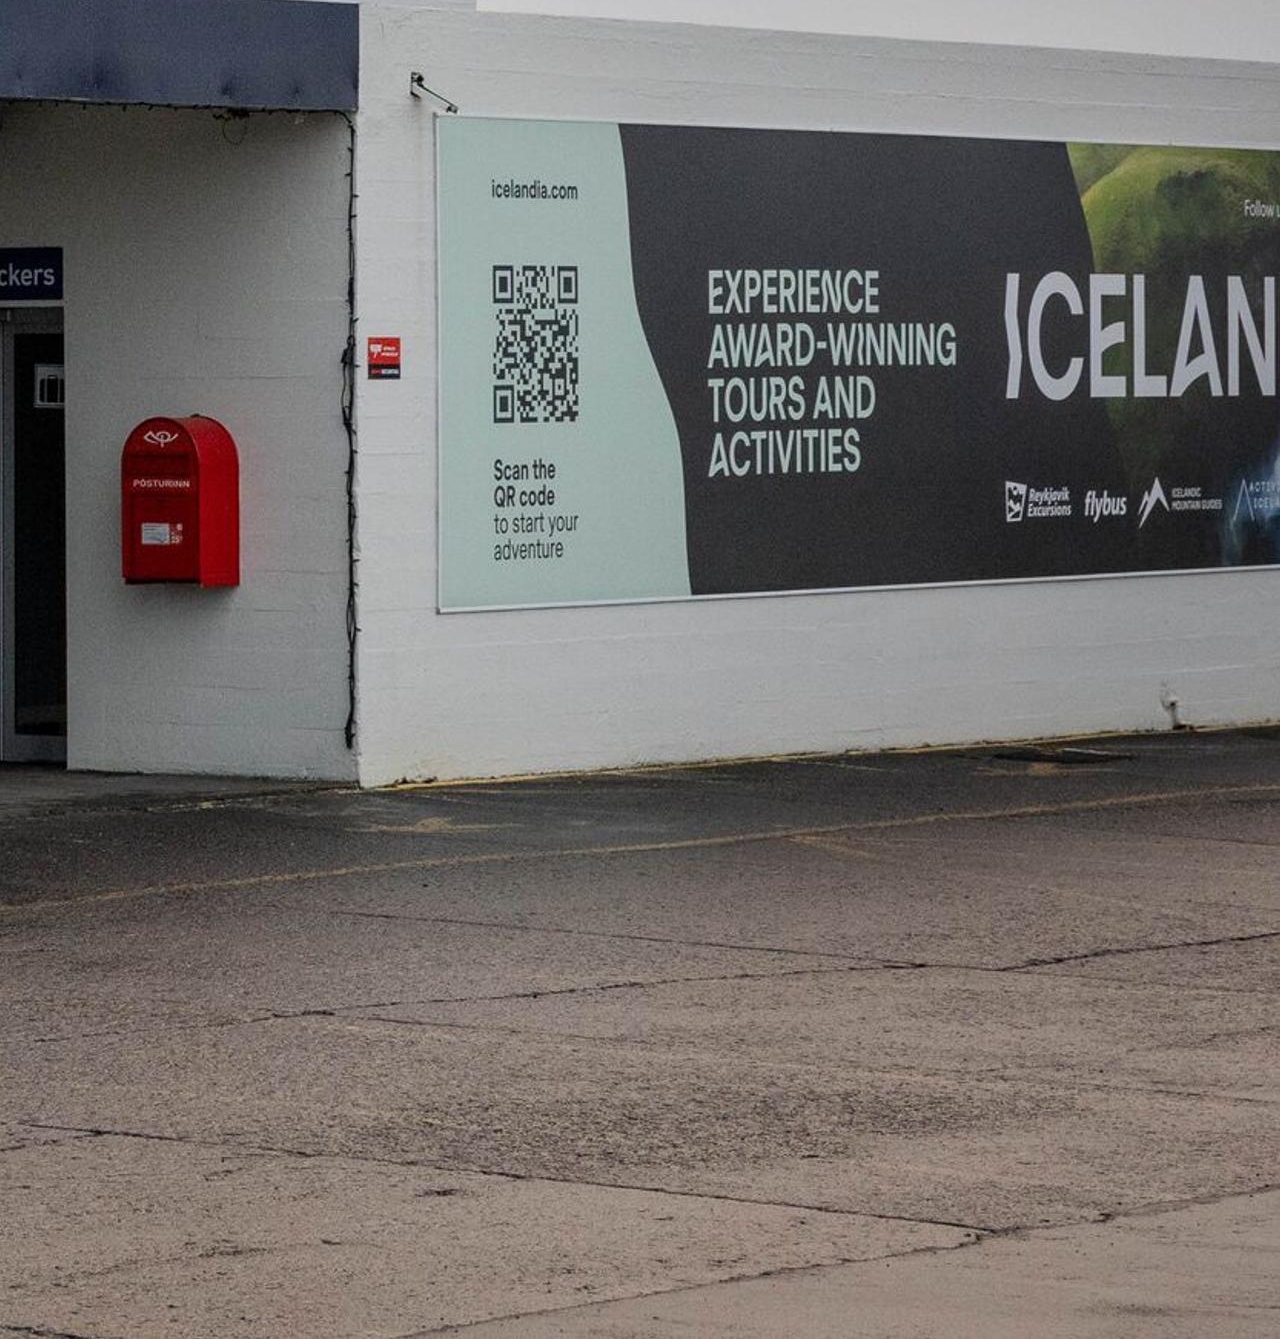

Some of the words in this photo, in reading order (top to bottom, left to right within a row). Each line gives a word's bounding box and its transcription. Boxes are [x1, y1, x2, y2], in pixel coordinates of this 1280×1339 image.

[491, 179, 577, 199] icelandia.com
[1244, 199, 1274, 217] Follow
[708, 270, 879, 314] EXPERIENCE
[707, 323, 956, 368] AWARD-WINNING
[708, 378, 806, 422] TOURS
[813, 376, 875, 420] AND
[708, 429, 861, 477] ACTIVITIES
[494, 459, 529, 481] Scan
[532, 458, 556, 479] the
[494, 485, 515, 508] QR
[519, 484, 555, 507] code
[1028, 487, 1070, 504] Reykjavik
[1172, 487, 1201, 498] ICELANDIC
[1027, 502, 1072, 517] Excursions
[1084, 490, 1127, 523] flybus
[494, 514, 508, 534] to
[512, 513, 545, 533] start
[548, 515, 579, 537] your
[494, 539, 564, 561] adventure
